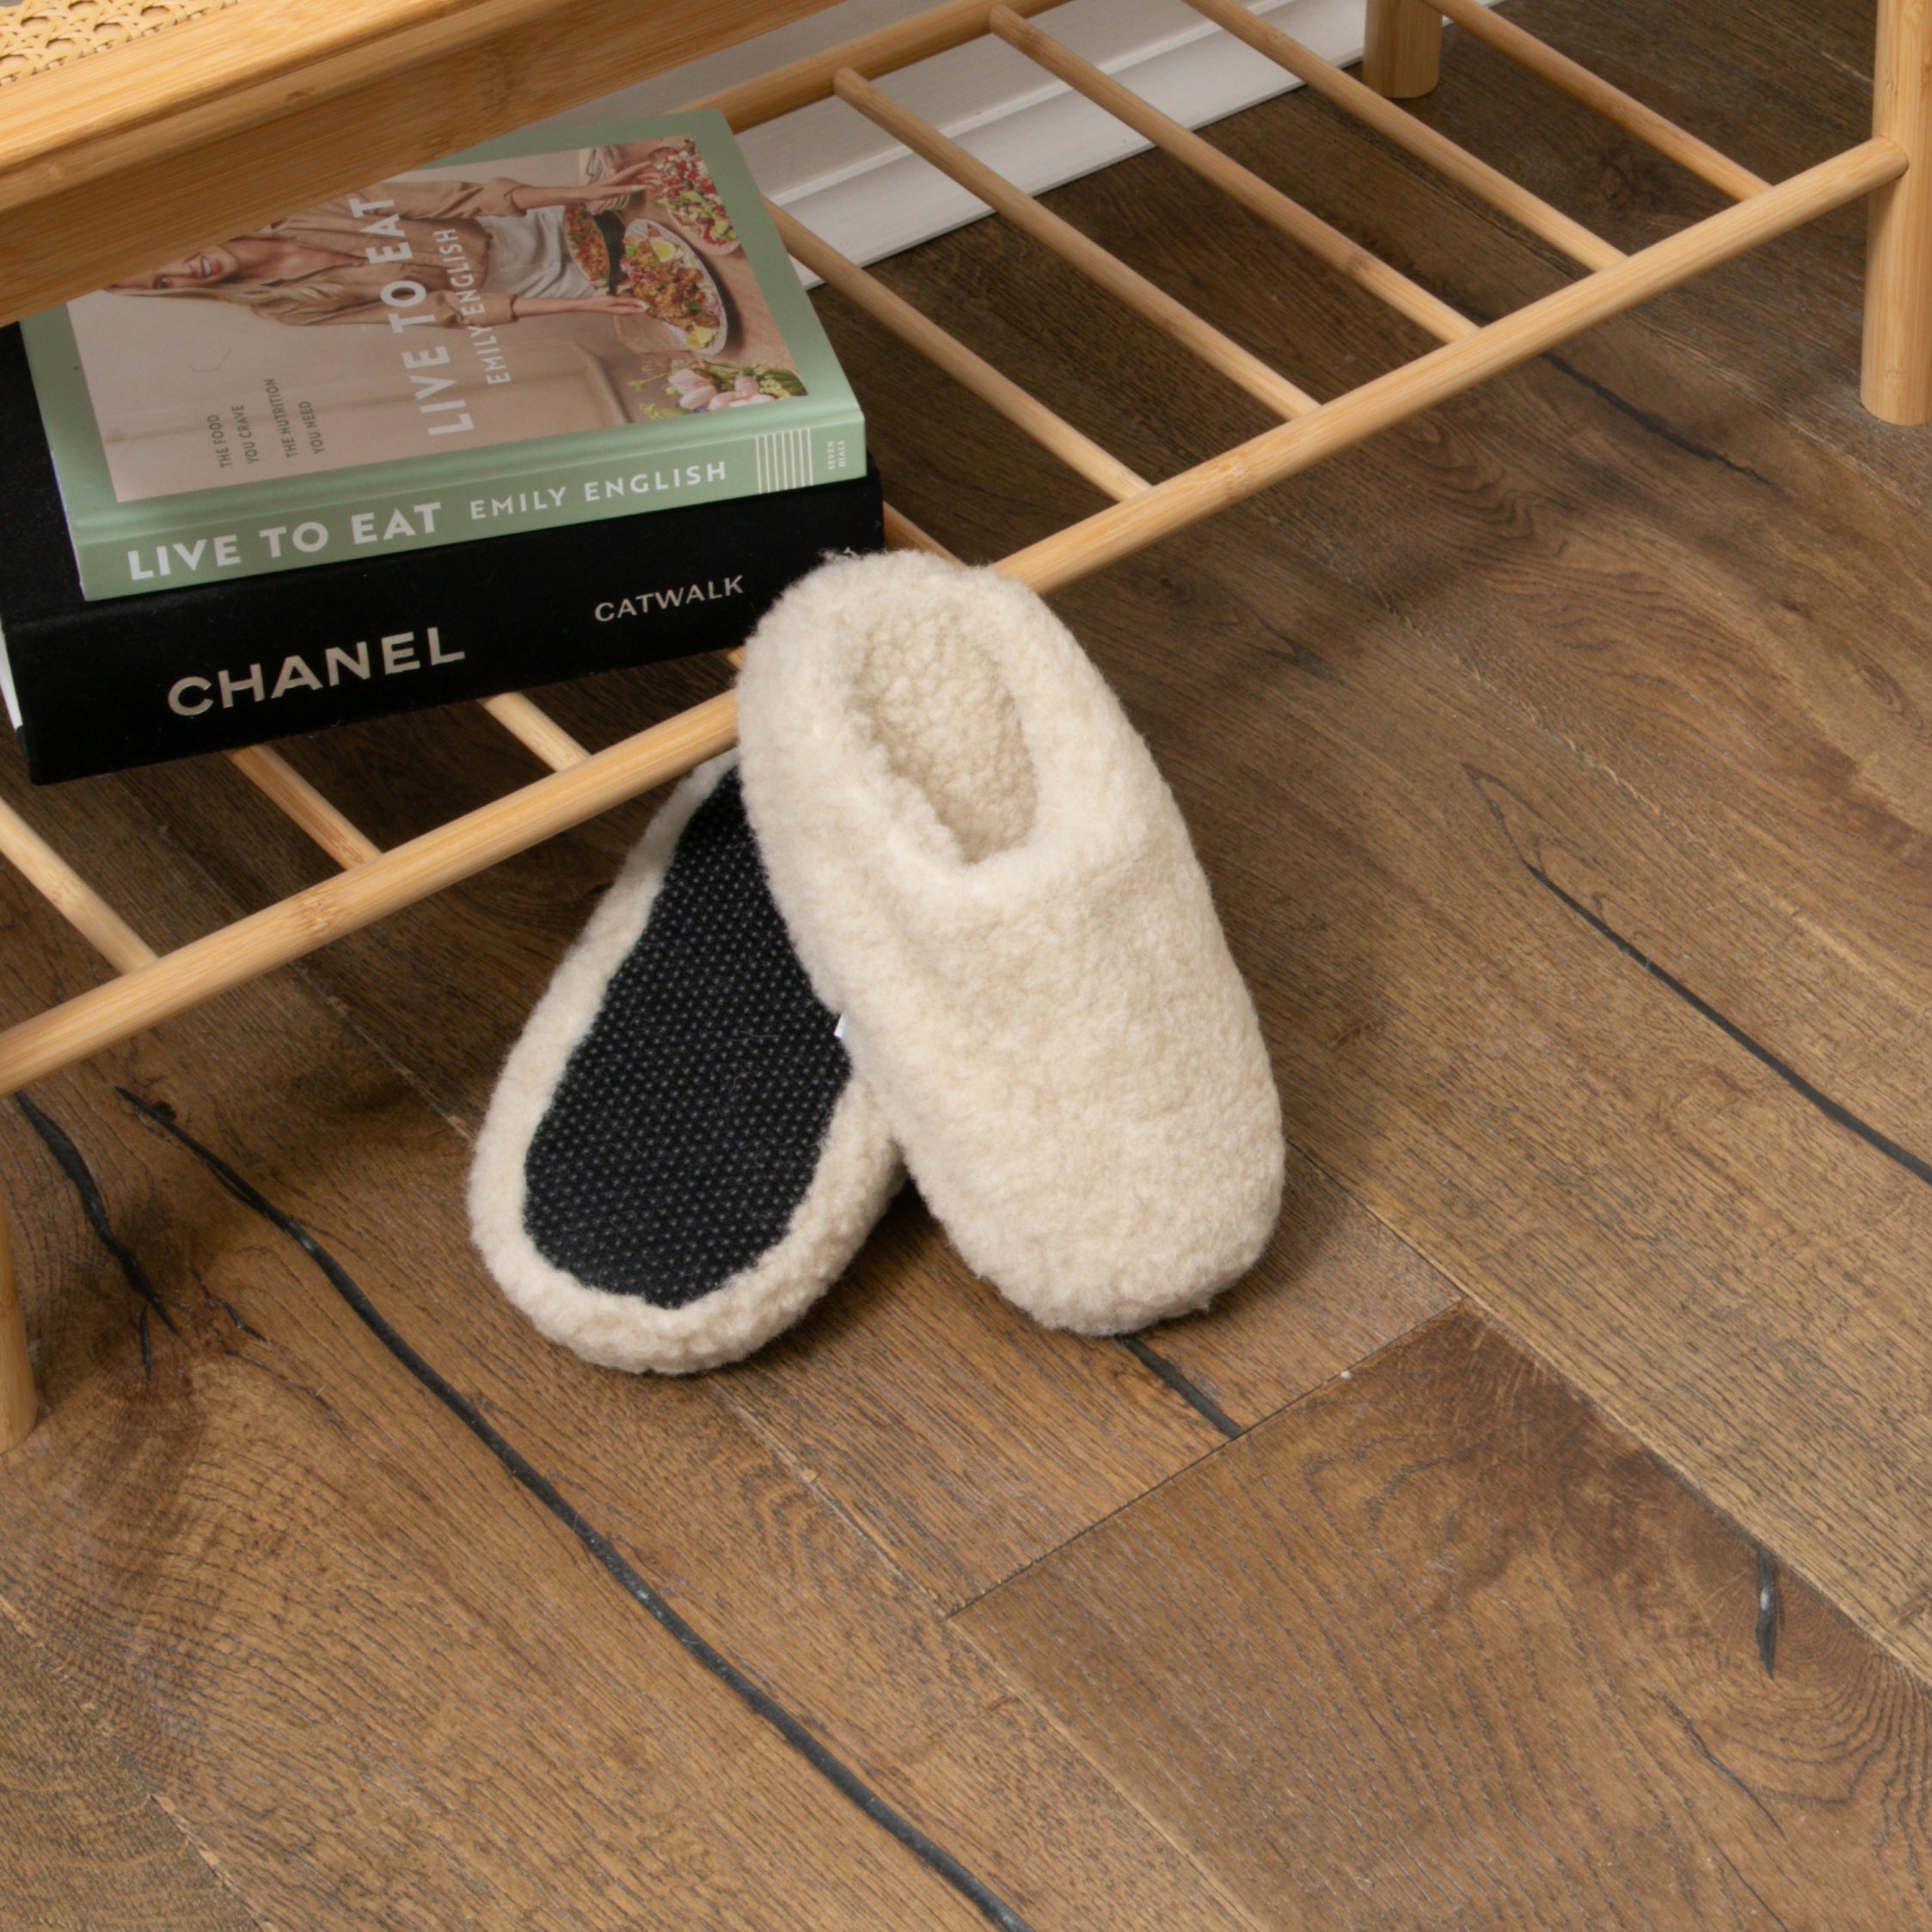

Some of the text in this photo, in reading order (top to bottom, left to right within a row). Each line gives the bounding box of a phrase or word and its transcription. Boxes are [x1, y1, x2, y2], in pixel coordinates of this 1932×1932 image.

[348, 198, 475, 435] LIVE TO EAT
[433, 228, 512, 385] EMILY ENGLISH
[206, 414, 233, 468] THE FOOD
[231, 404, 259, 464] YOU CRAVE
[263, 378, 298, 458] THE NUTRITION
[298, 401, 325, 454] YOU NEED
[469, 461, 727, 520] EMILY ENGLISH
[127, 501, 441, 580] LIVE TO EAT
[594, 574, 744, 622] CATWALK
[168, 627, 465, 716] CHANEL
